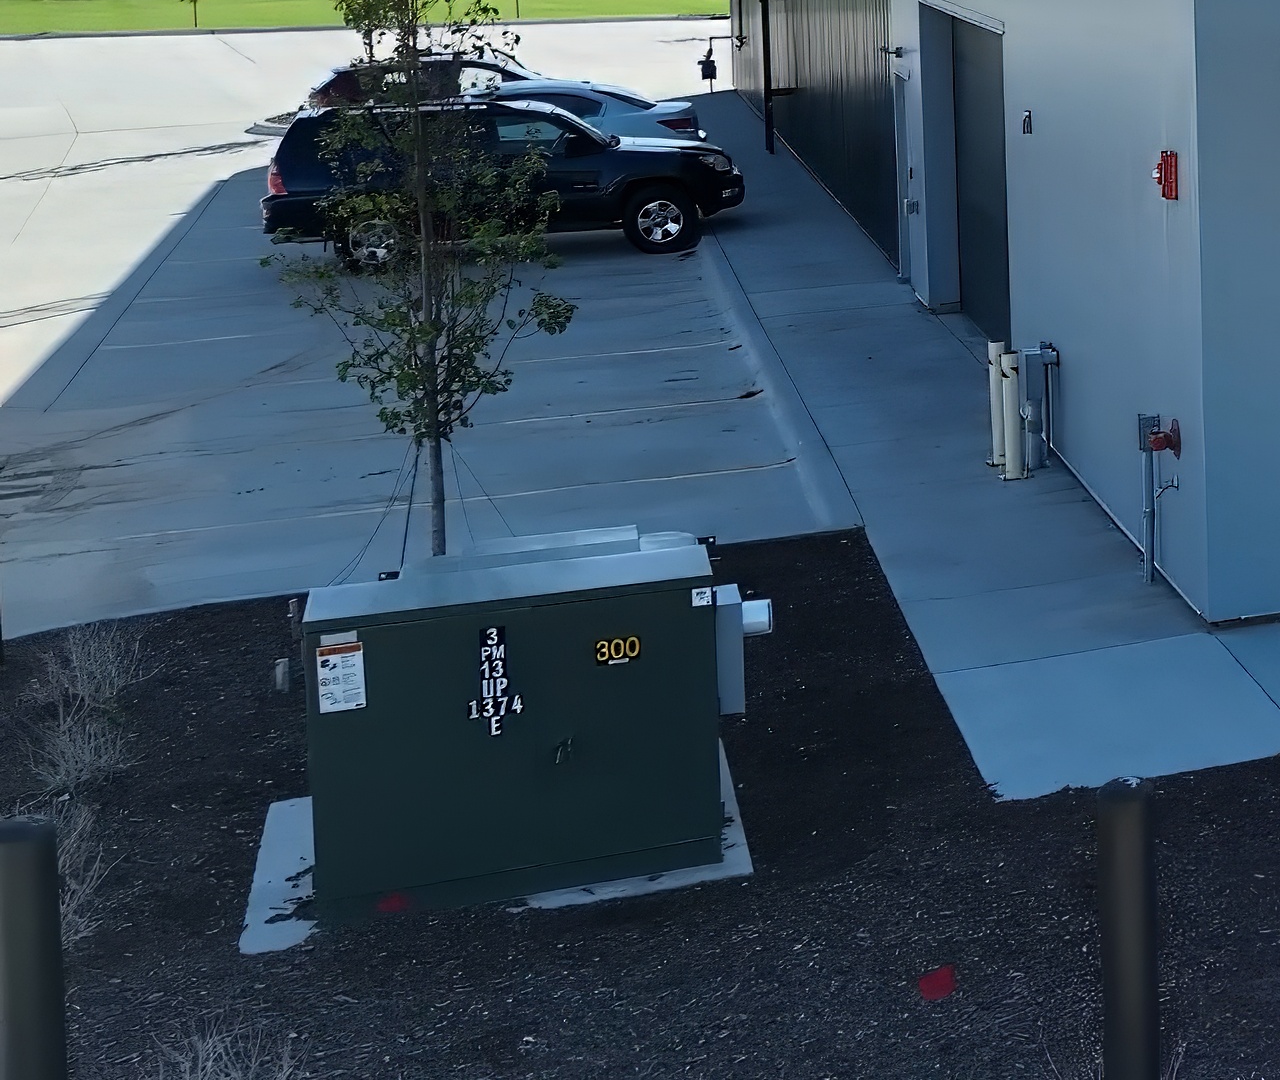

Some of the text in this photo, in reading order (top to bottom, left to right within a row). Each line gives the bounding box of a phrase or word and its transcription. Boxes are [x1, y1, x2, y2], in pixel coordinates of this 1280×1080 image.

[486, 627, 498, 645] 3
[481, 644, 505, 661] PM
[596, 636, 640, 661] 300
[480, 660, 504, 678] 13
[482, 678, 508, 698] UP
[468, 695, 524, 719] 1374
[490, 716, 502, 735] E
